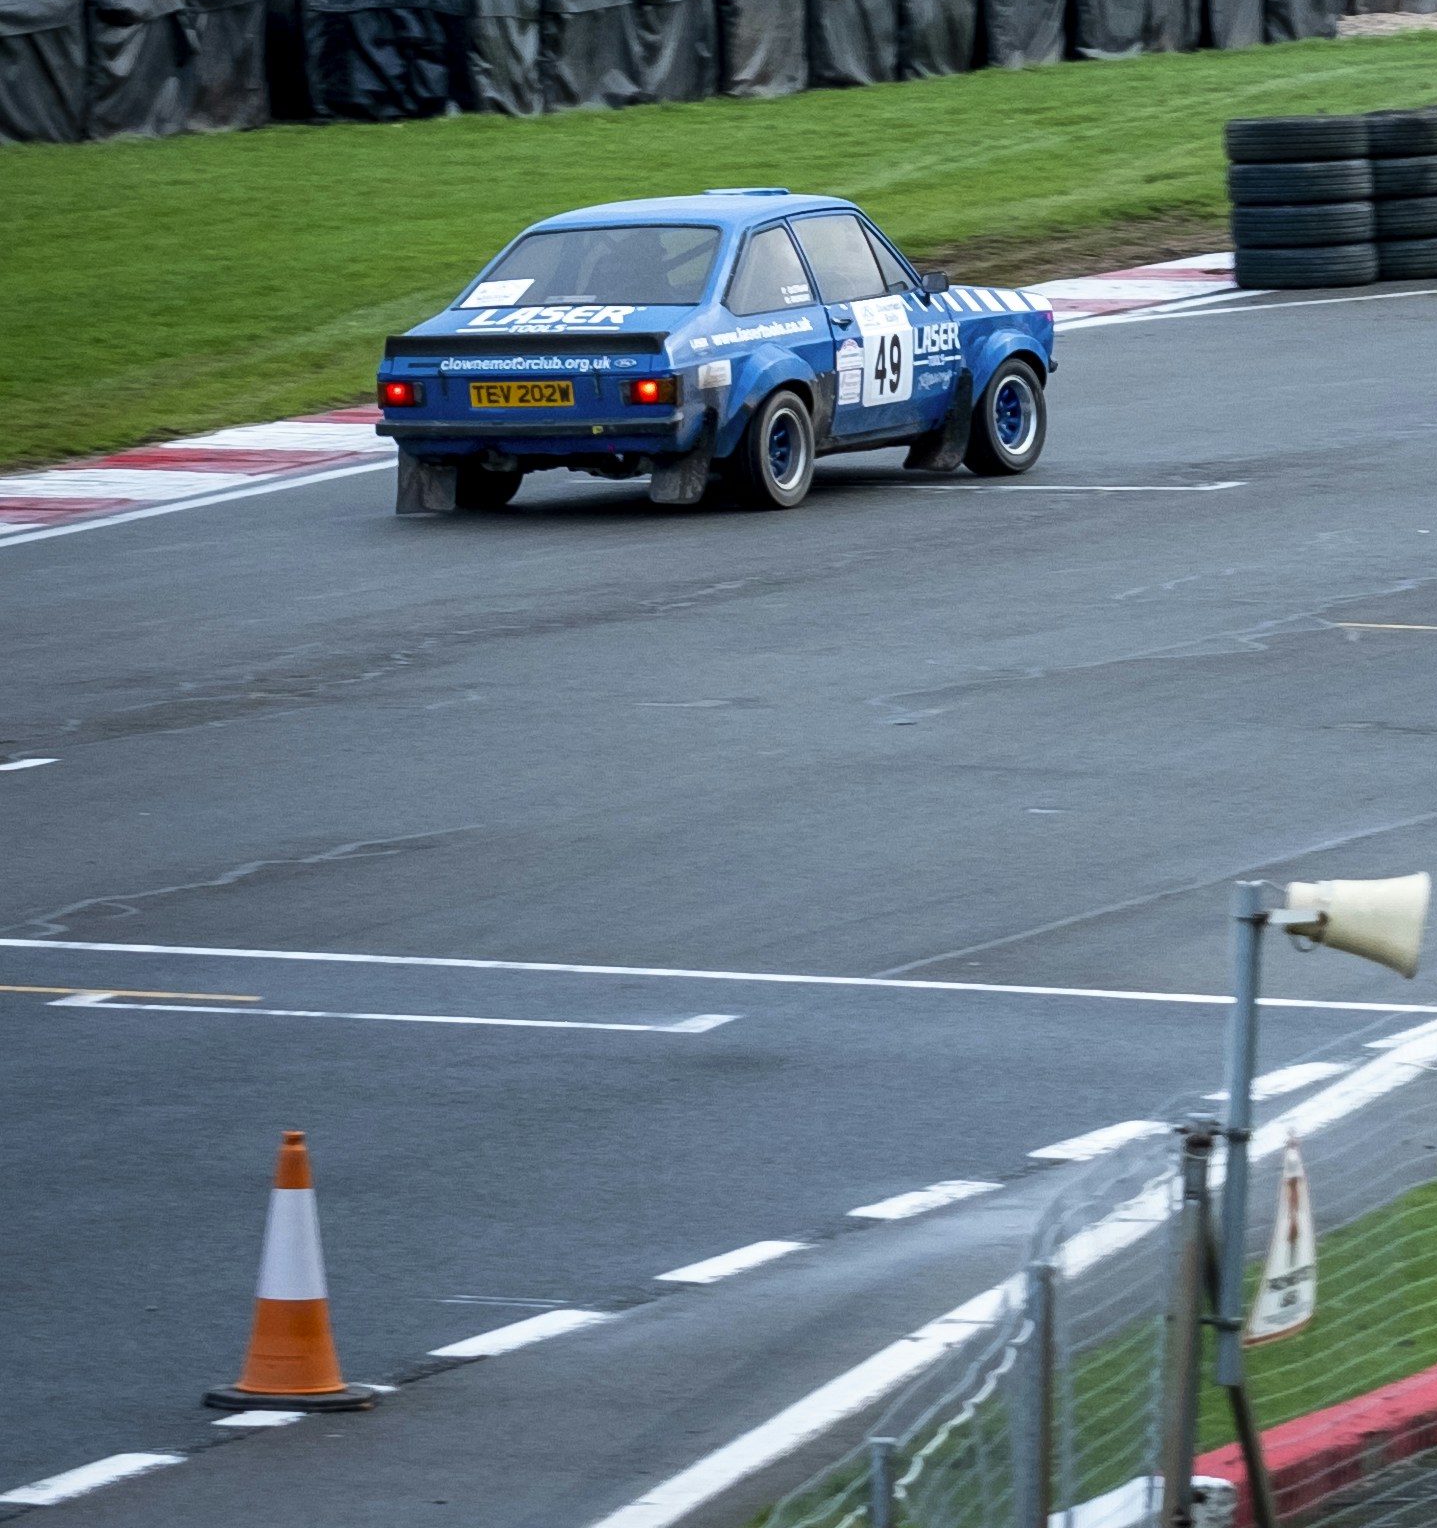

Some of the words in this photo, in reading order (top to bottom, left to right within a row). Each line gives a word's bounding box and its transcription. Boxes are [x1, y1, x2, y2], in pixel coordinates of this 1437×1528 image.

[467, 305, 637, 326] LASER
[509, 324, 567, 333] TOOLS
[913, 321, 961, 354] LASER
[440, 356, 611, 371] clownemotorclub.org.uk
[875, 334, 901, 395] 49
[472, 385, 512, 404] TEV
[518, 384, 571, 403] 202W
